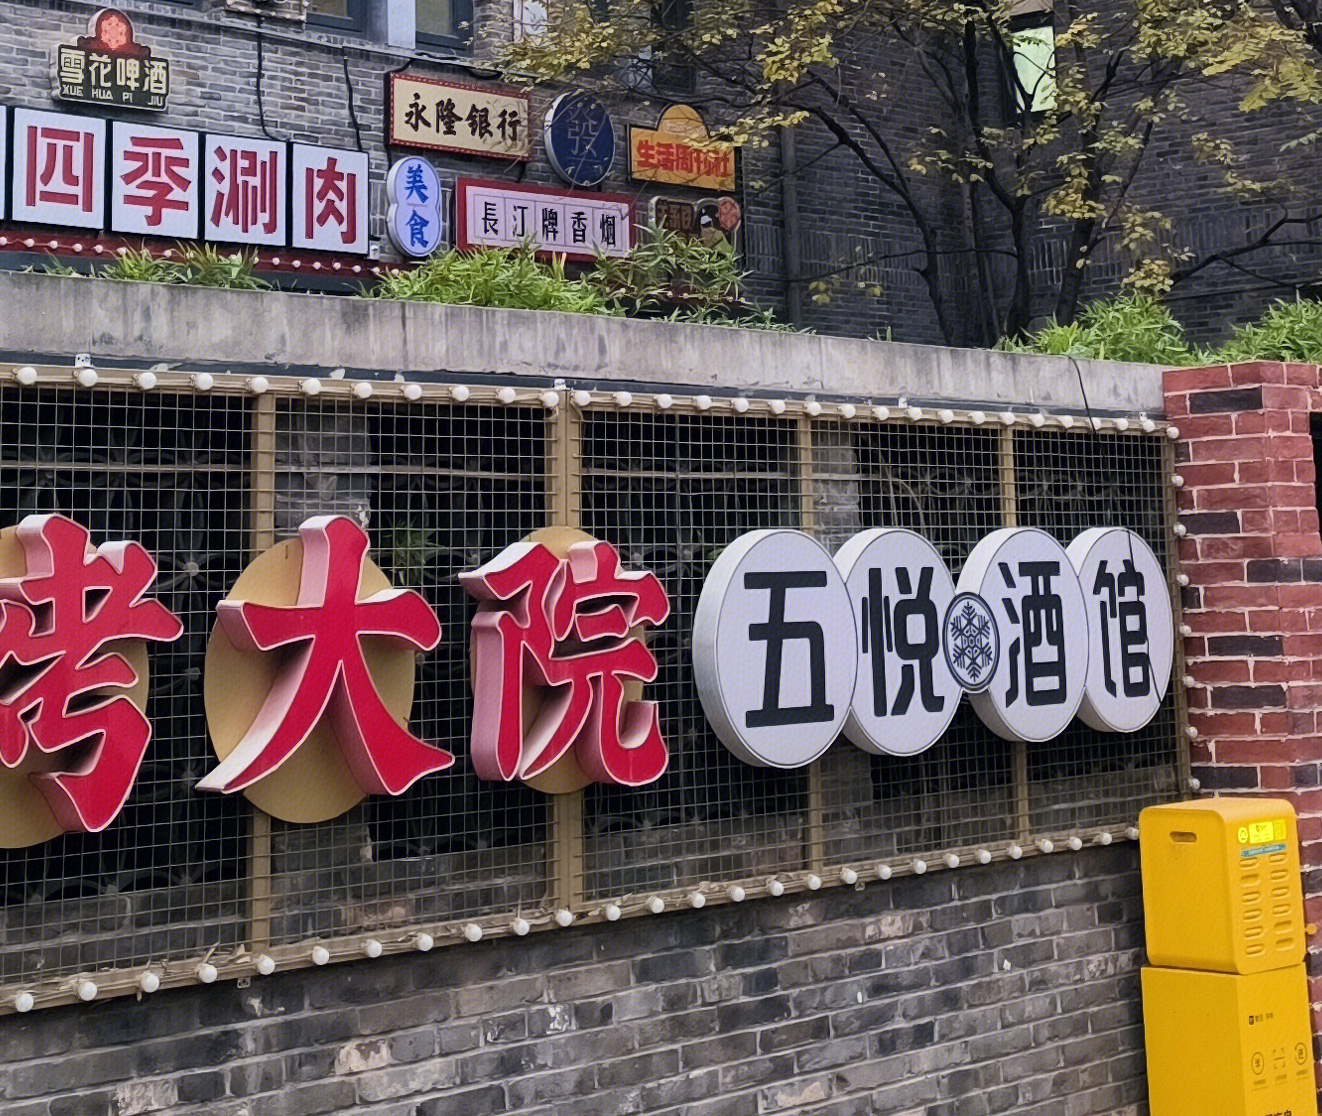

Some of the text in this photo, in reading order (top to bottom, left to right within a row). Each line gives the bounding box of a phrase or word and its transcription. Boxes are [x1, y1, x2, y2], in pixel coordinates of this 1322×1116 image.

[59, 47, 167, 95] 雪花啤酒
[62, 84, 164, 107] XUE HUA PI JIU
[404, 164, 430, 249] 美食
[743, 559, 1151, 729] 五悦酒馆
